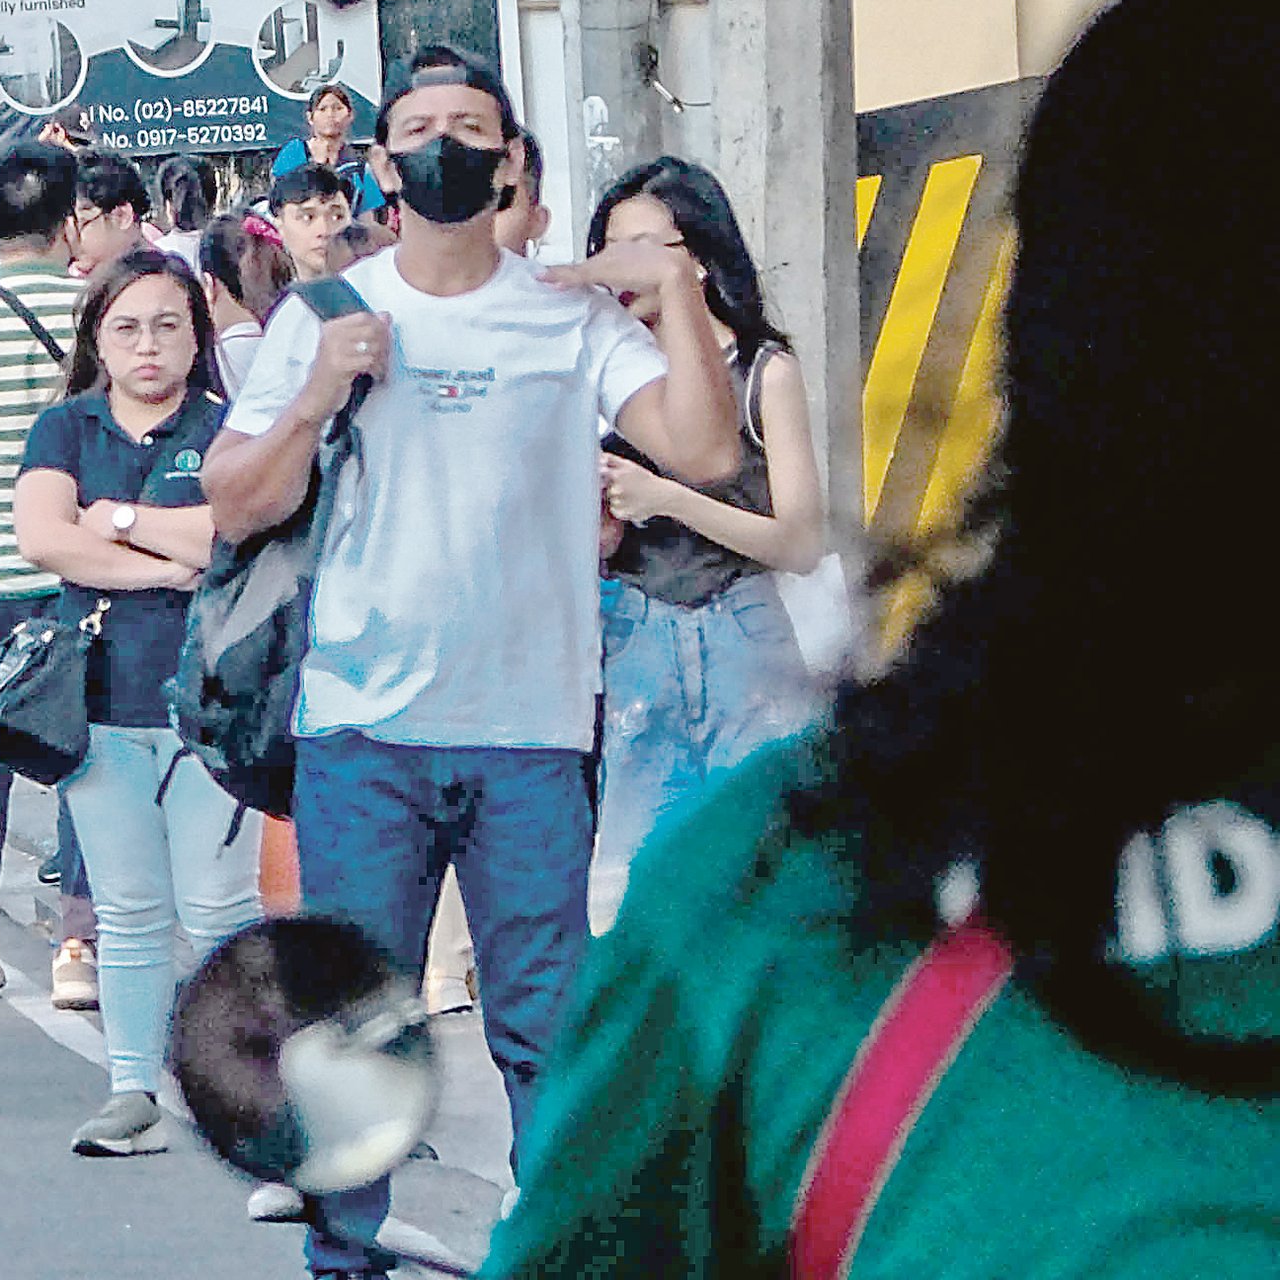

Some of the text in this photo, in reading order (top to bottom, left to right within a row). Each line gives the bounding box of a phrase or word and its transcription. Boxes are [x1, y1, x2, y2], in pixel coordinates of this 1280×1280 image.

[99, 105, 130, 123] No.
[134, 95, 268, 123] (02)-85227841
[103, 123, 267, 149] No. 0917-5270392
